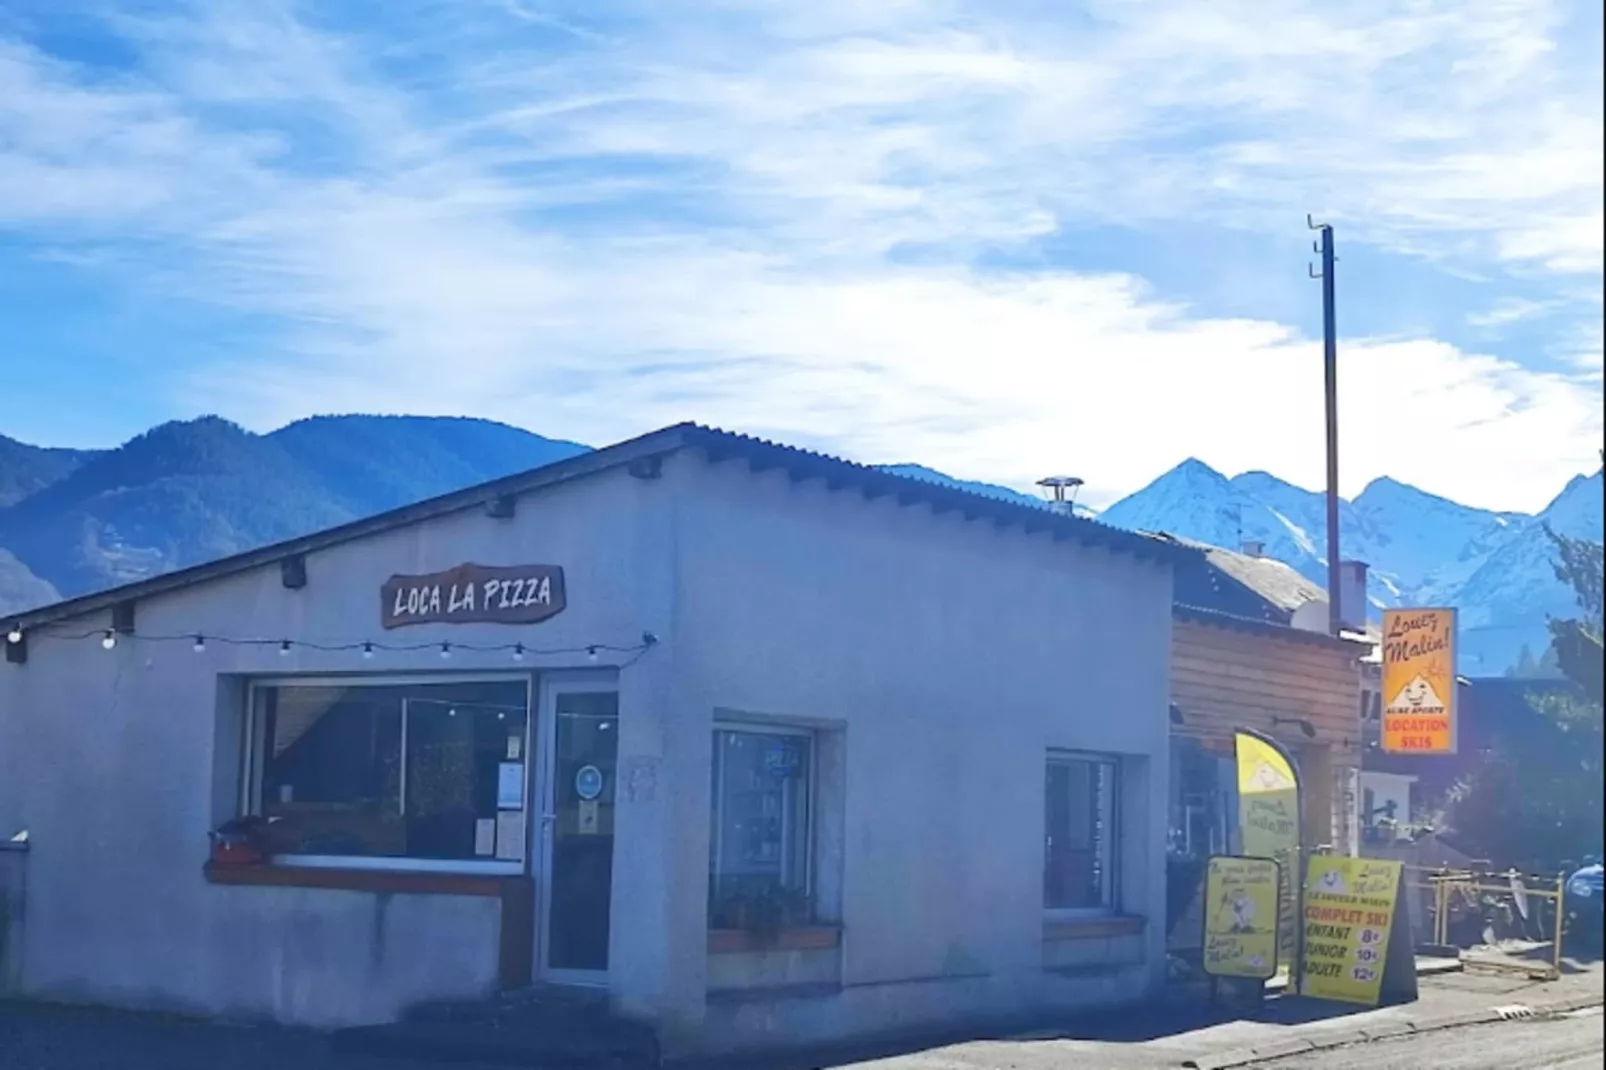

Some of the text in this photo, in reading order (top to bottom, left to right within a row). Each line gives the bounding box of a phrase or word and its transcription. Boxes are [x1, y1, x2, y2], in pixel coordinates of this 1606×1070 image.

[393, 576, 550, 617] LOCA LA PIZZA
[1385, 627, 1450, 663] Malin!
[1385, 719, 1449, 732] LOCATION
[1402, 736, 1432, 749] SKIS
[1305, 905, 1389, 927] COMPLET SKI
